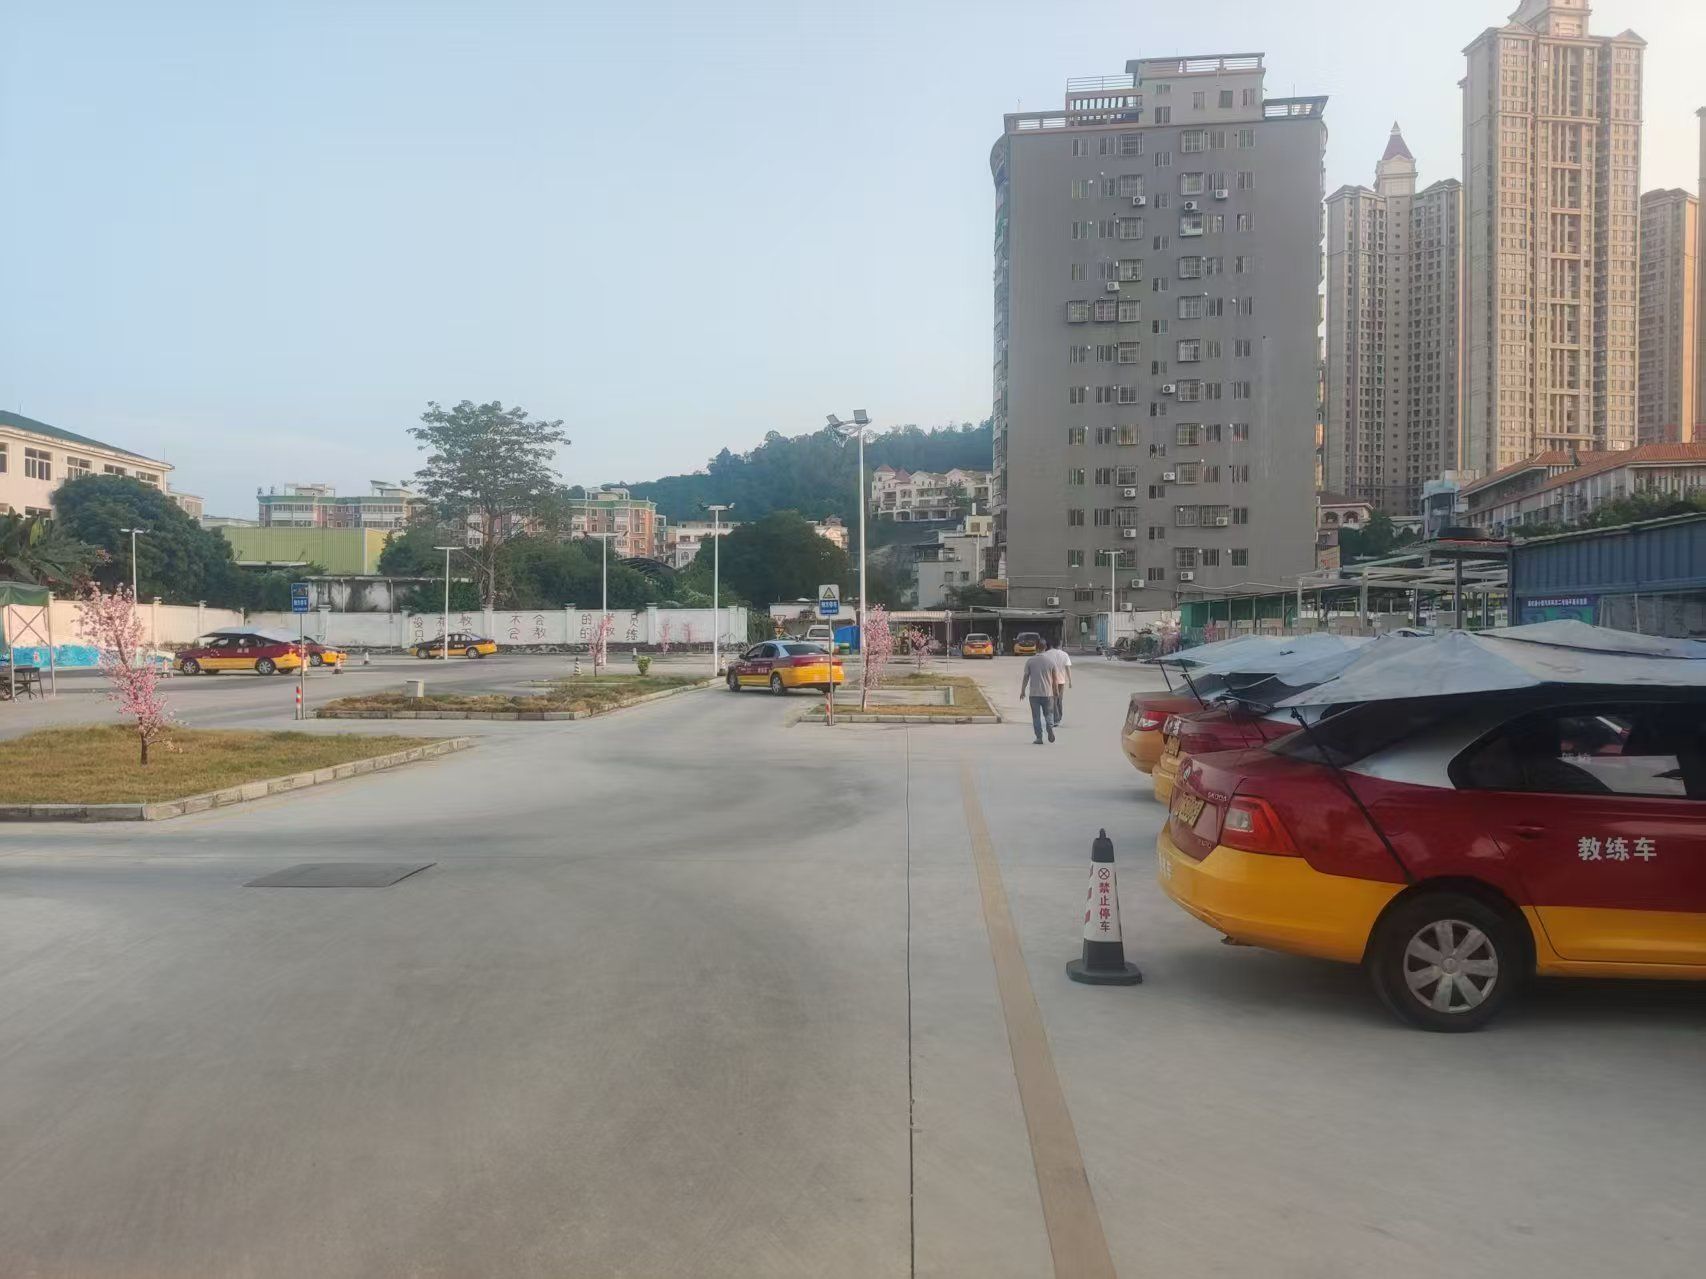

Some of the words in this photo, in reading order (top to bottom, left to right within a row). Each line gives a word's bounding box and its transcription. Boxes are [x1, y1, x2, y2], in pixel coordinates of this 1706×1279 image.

[1578, 836, 1657, 861] 教练车
[1099, 882, 1111, 932] 禁止停车
